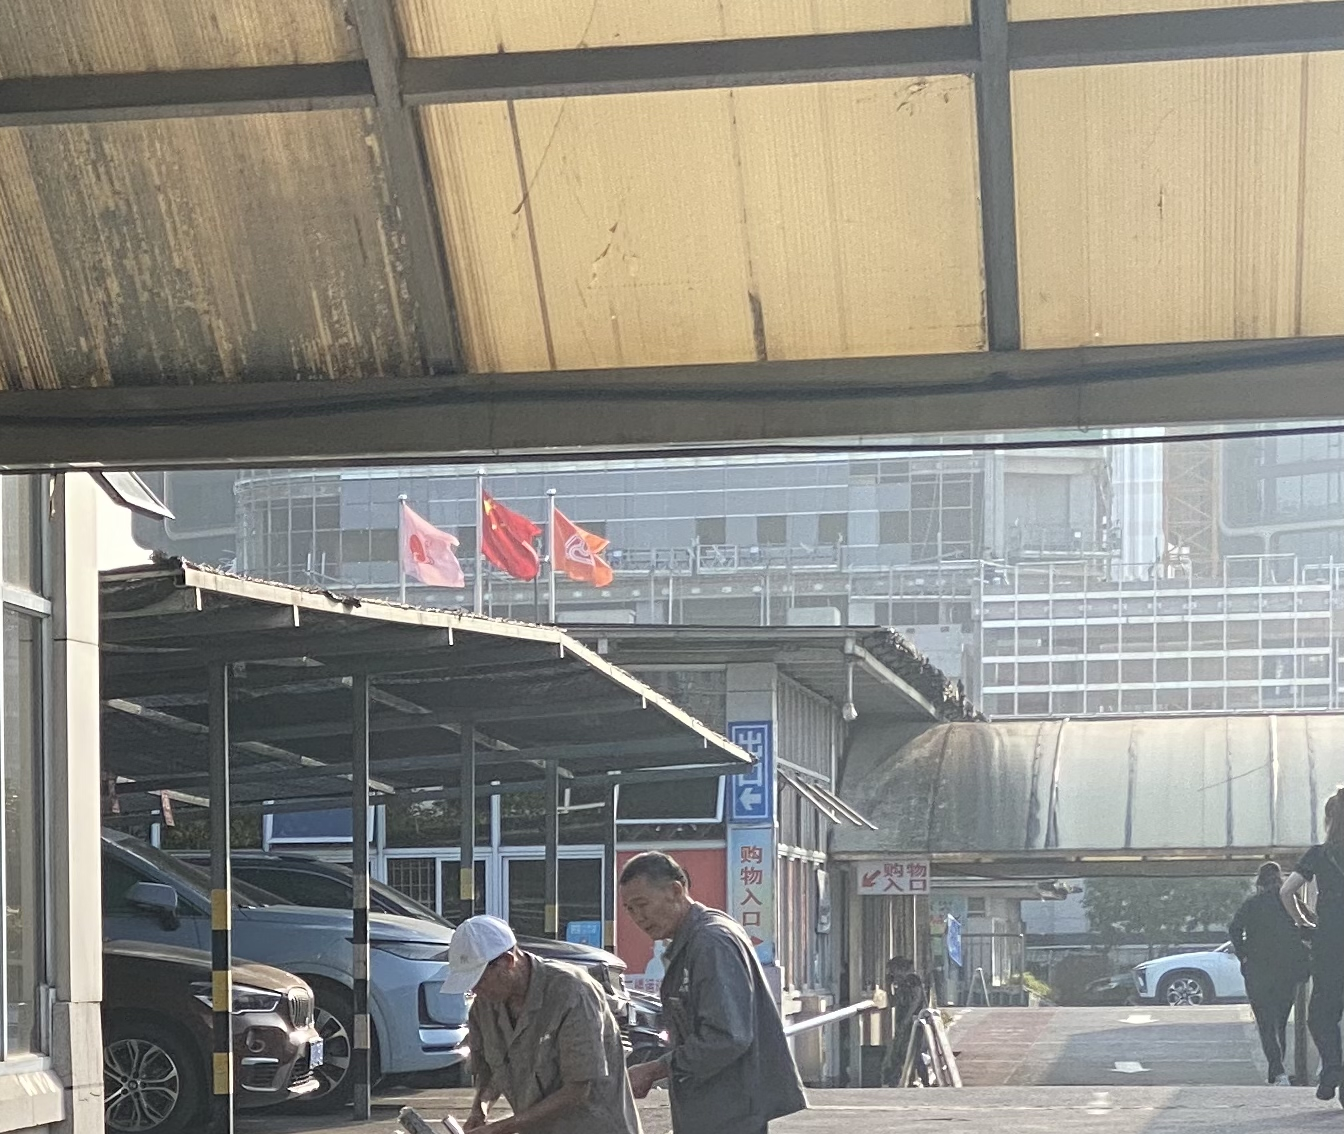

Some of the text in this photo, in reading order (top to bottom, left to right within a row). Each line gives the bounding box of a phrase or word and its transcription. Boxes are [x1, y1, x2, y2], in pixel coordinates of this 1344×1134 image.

[738, 730, 763, 787] 出口
[740, 846, 763, 926] 购物入口
[883, 863, 927, 877] 购物
[883, 879, 927, 892] 入口
